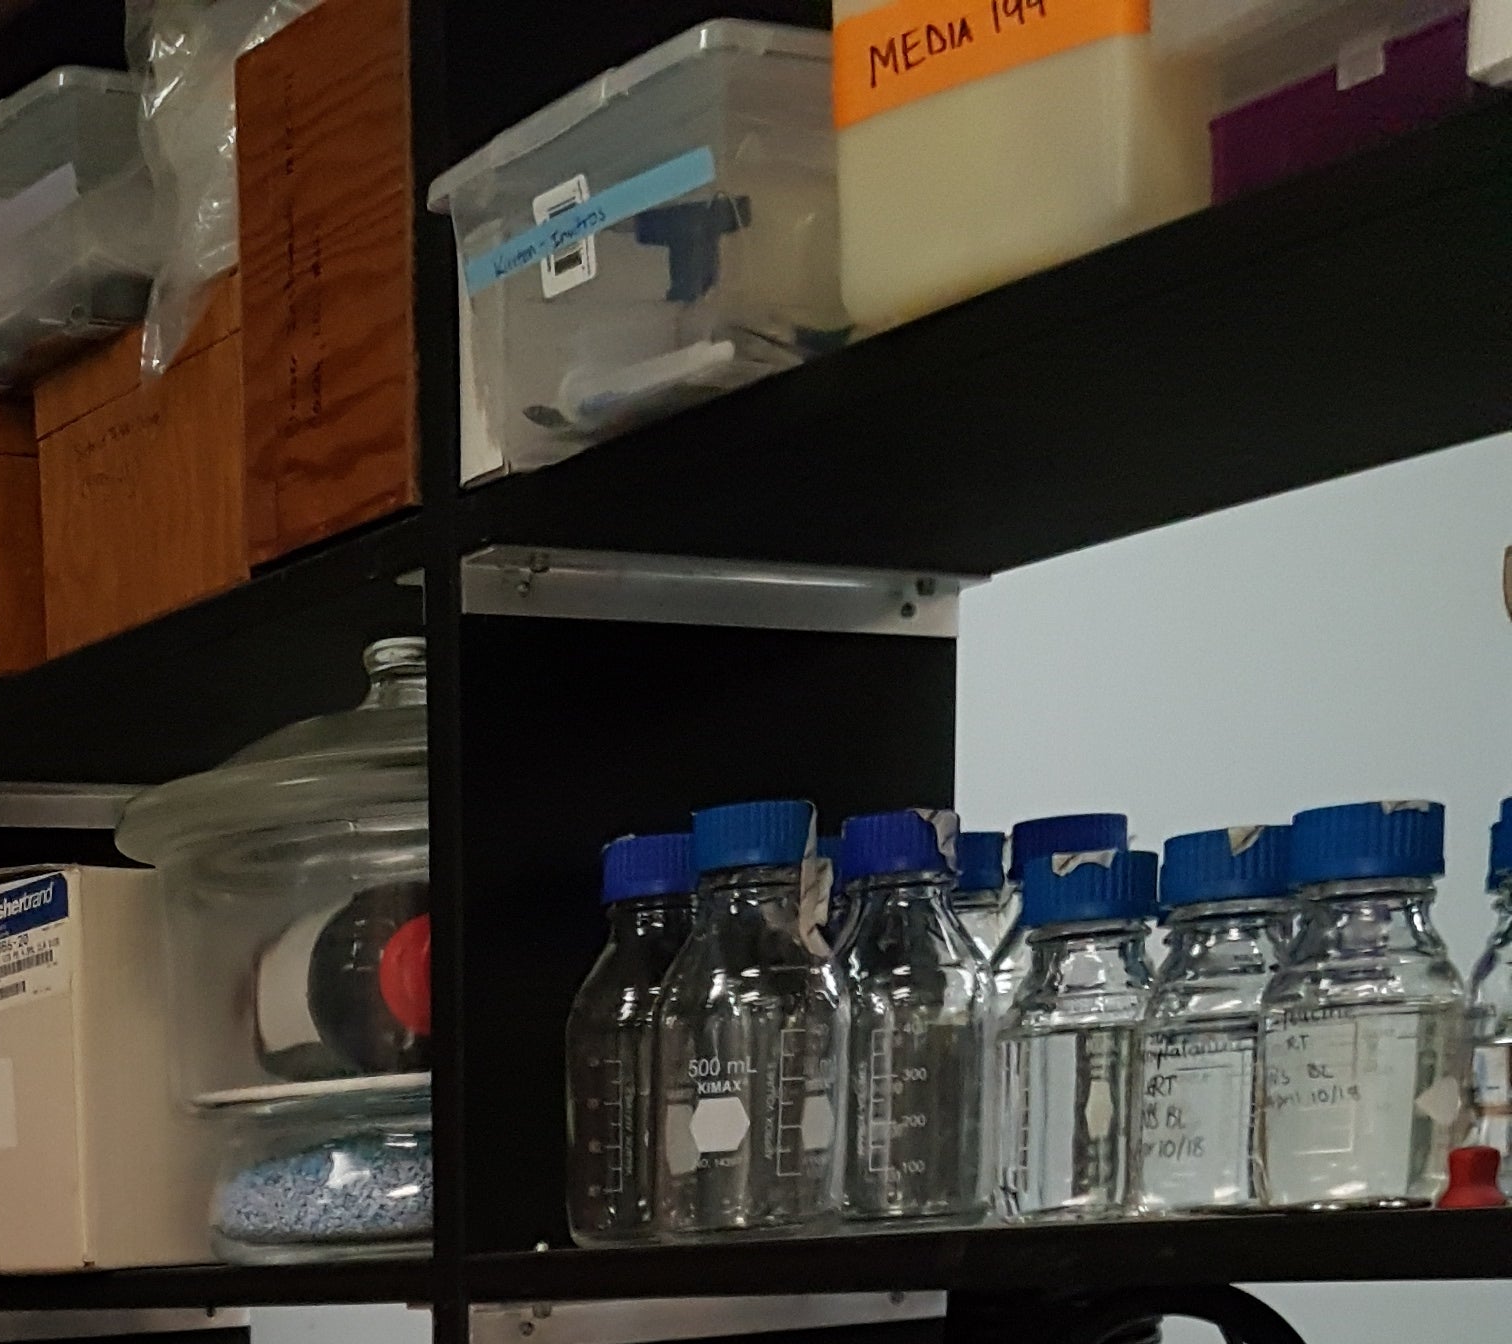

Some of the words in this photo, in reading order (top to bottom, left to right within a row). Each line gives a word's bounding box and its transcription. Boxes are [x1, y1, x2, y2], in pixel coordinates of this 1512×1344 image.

[869, 17, 974, 89] MEDIA
[688, 1057, 721, 1079] 500
[727, 1055, 758, 1074] mL
[902, 1066, 928, 1081] 300
[697, 1079, 742, 1095] KIMAX
[902, 1113, 928, 1128] 200
[902, 1159, 926, 1174] 100
